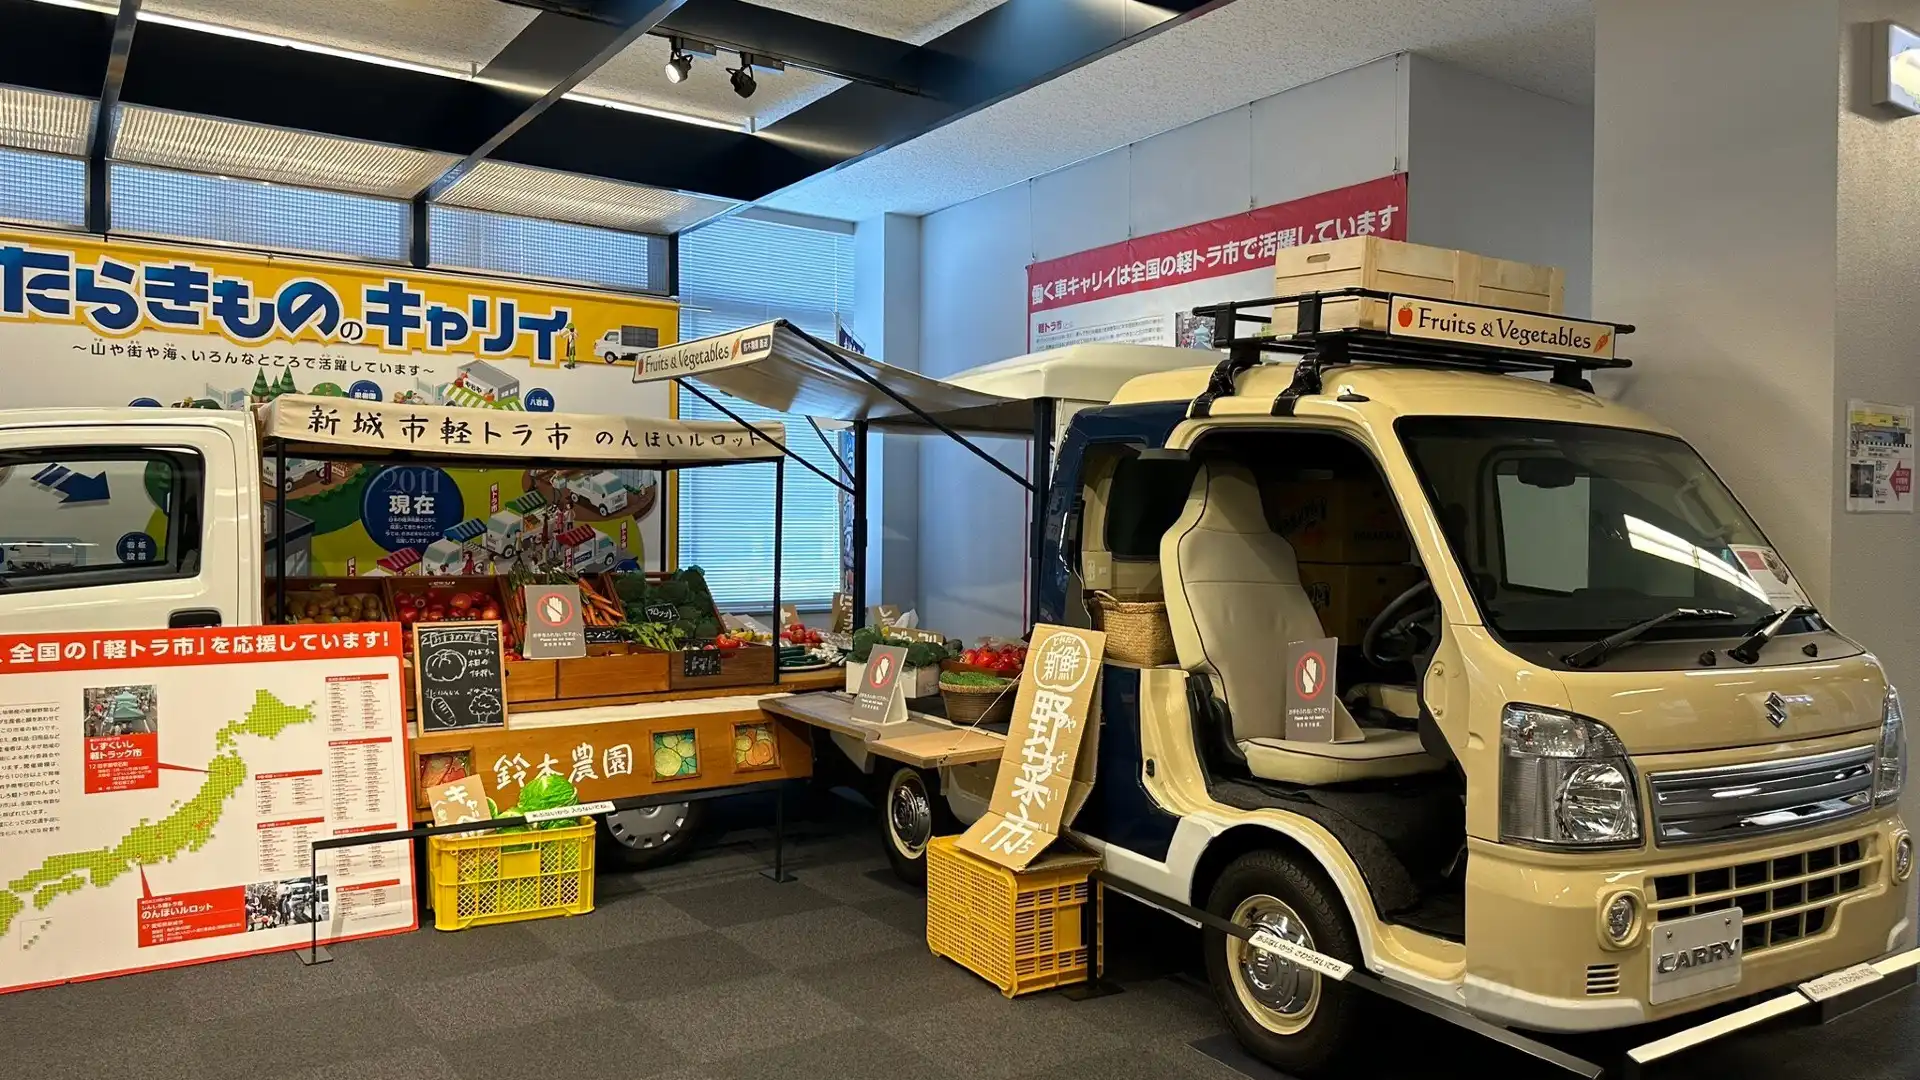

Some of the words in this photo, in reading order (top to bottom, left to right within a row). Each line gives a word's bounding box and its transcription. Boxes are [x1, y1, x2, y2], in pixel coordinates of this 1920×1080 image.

[1031, 204, 1399, 305] 働く車キャリイは全国の軽トラ市で活躍しています
[1418, 307, 1476, 336] Fruits
[1481, 321, 1495, 338] &
[1496, 317, 1592, 350] Vegetables
[645, 354, 669, 374] Fruits
[678, 340, 730, 371] Vegetables
[308, 404, 572, 451] 新城市軽トラ市
[382, 469, 440, 493] 2011
[388, 494, 435, 515] 現在
[89, 748, 143, 761] 軽トラック市
[90, 740, 135, 752] しずくいし
[492, 742, 634, 791] 鈴木農園
[981, 690, 1074, 857] 野菜市
[141, 903, 214, 920] のんほいルロット
[1656, 937, 1741, 974] CARRY
